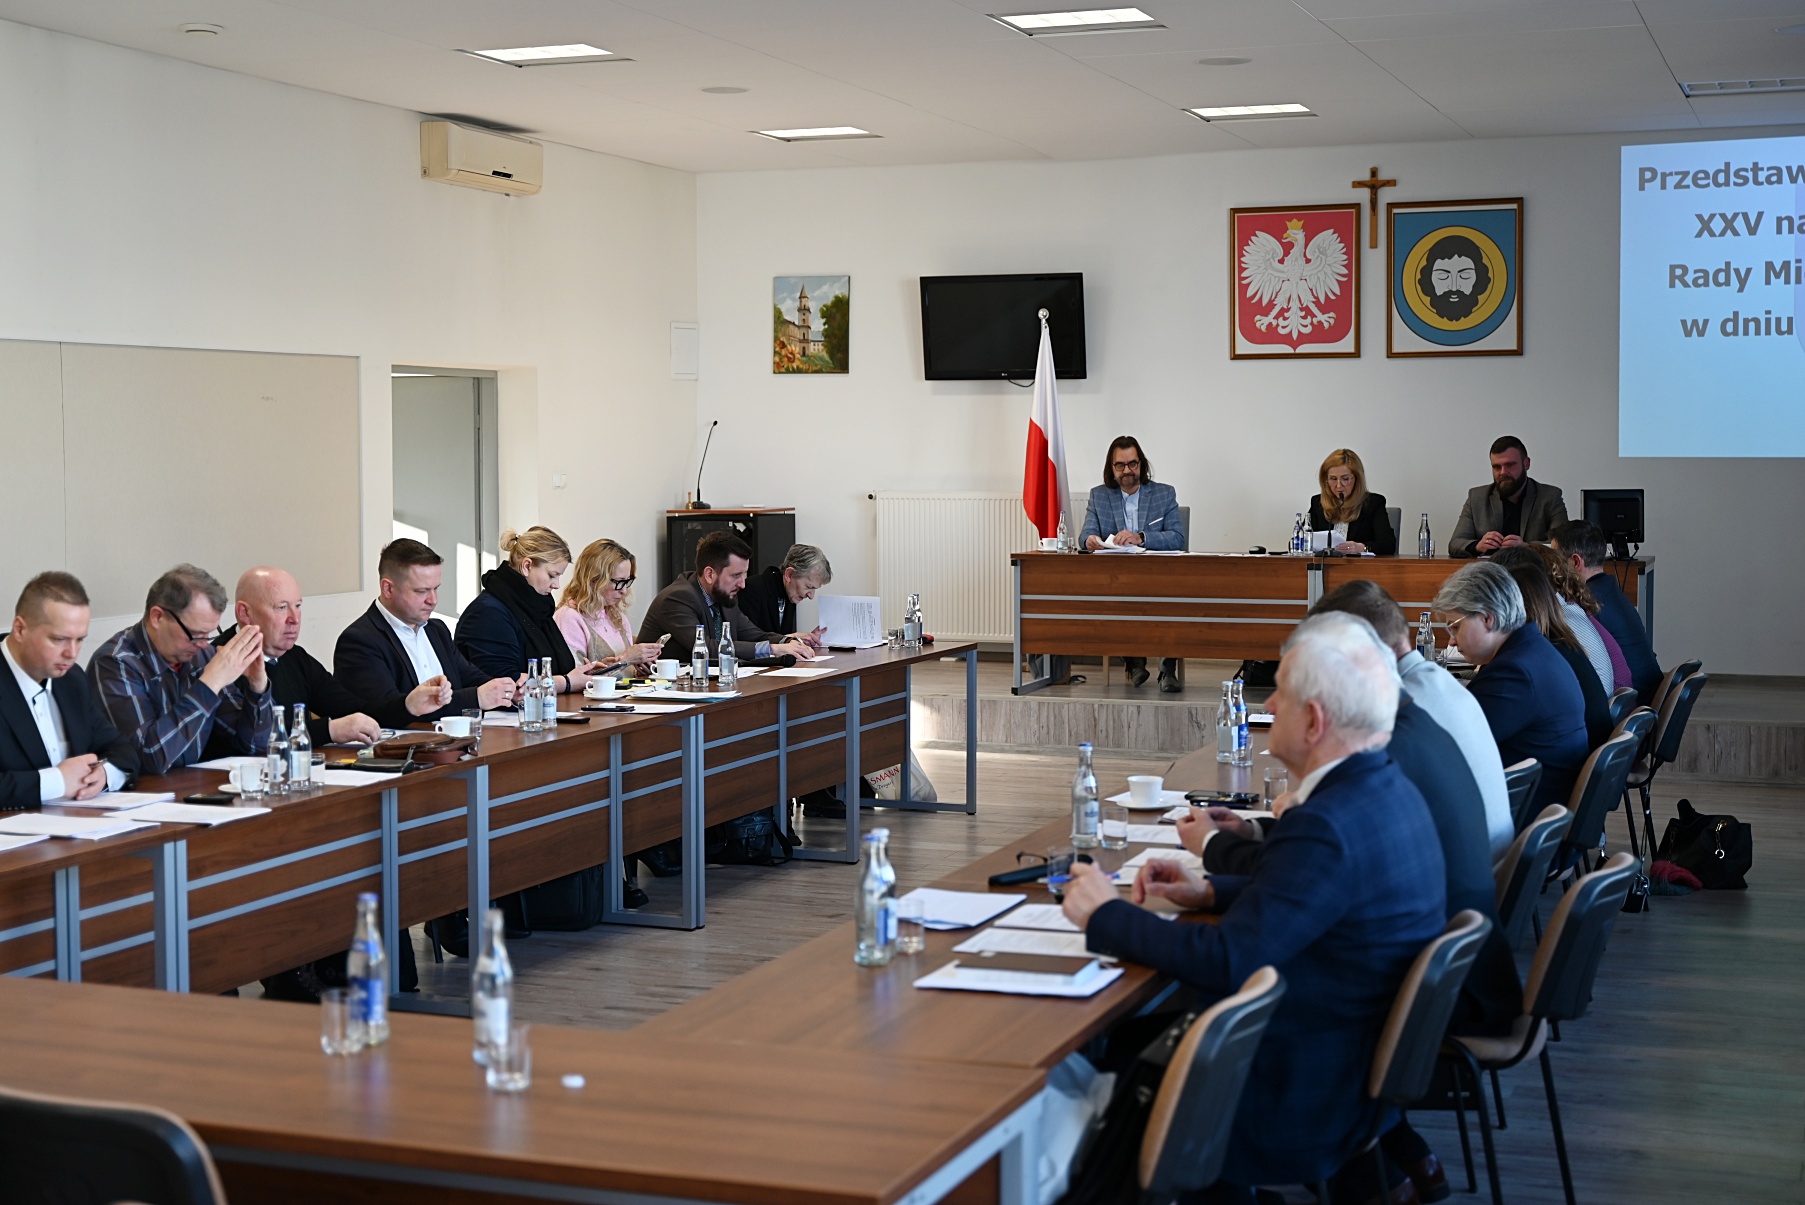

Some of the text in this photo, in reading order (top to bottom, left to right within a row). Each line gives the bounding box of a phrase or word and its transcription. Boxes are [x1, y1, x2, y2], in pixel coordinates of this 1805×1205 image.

[1638, 161, 1805, 192] Przedstaw
[1694, 211, 1764, 239] XXV
[1668, 258, 1805, 293] Rady Mi
[1680, 309, 1793, 338] w dniu
[869, 766, 900, 785] SMANN
